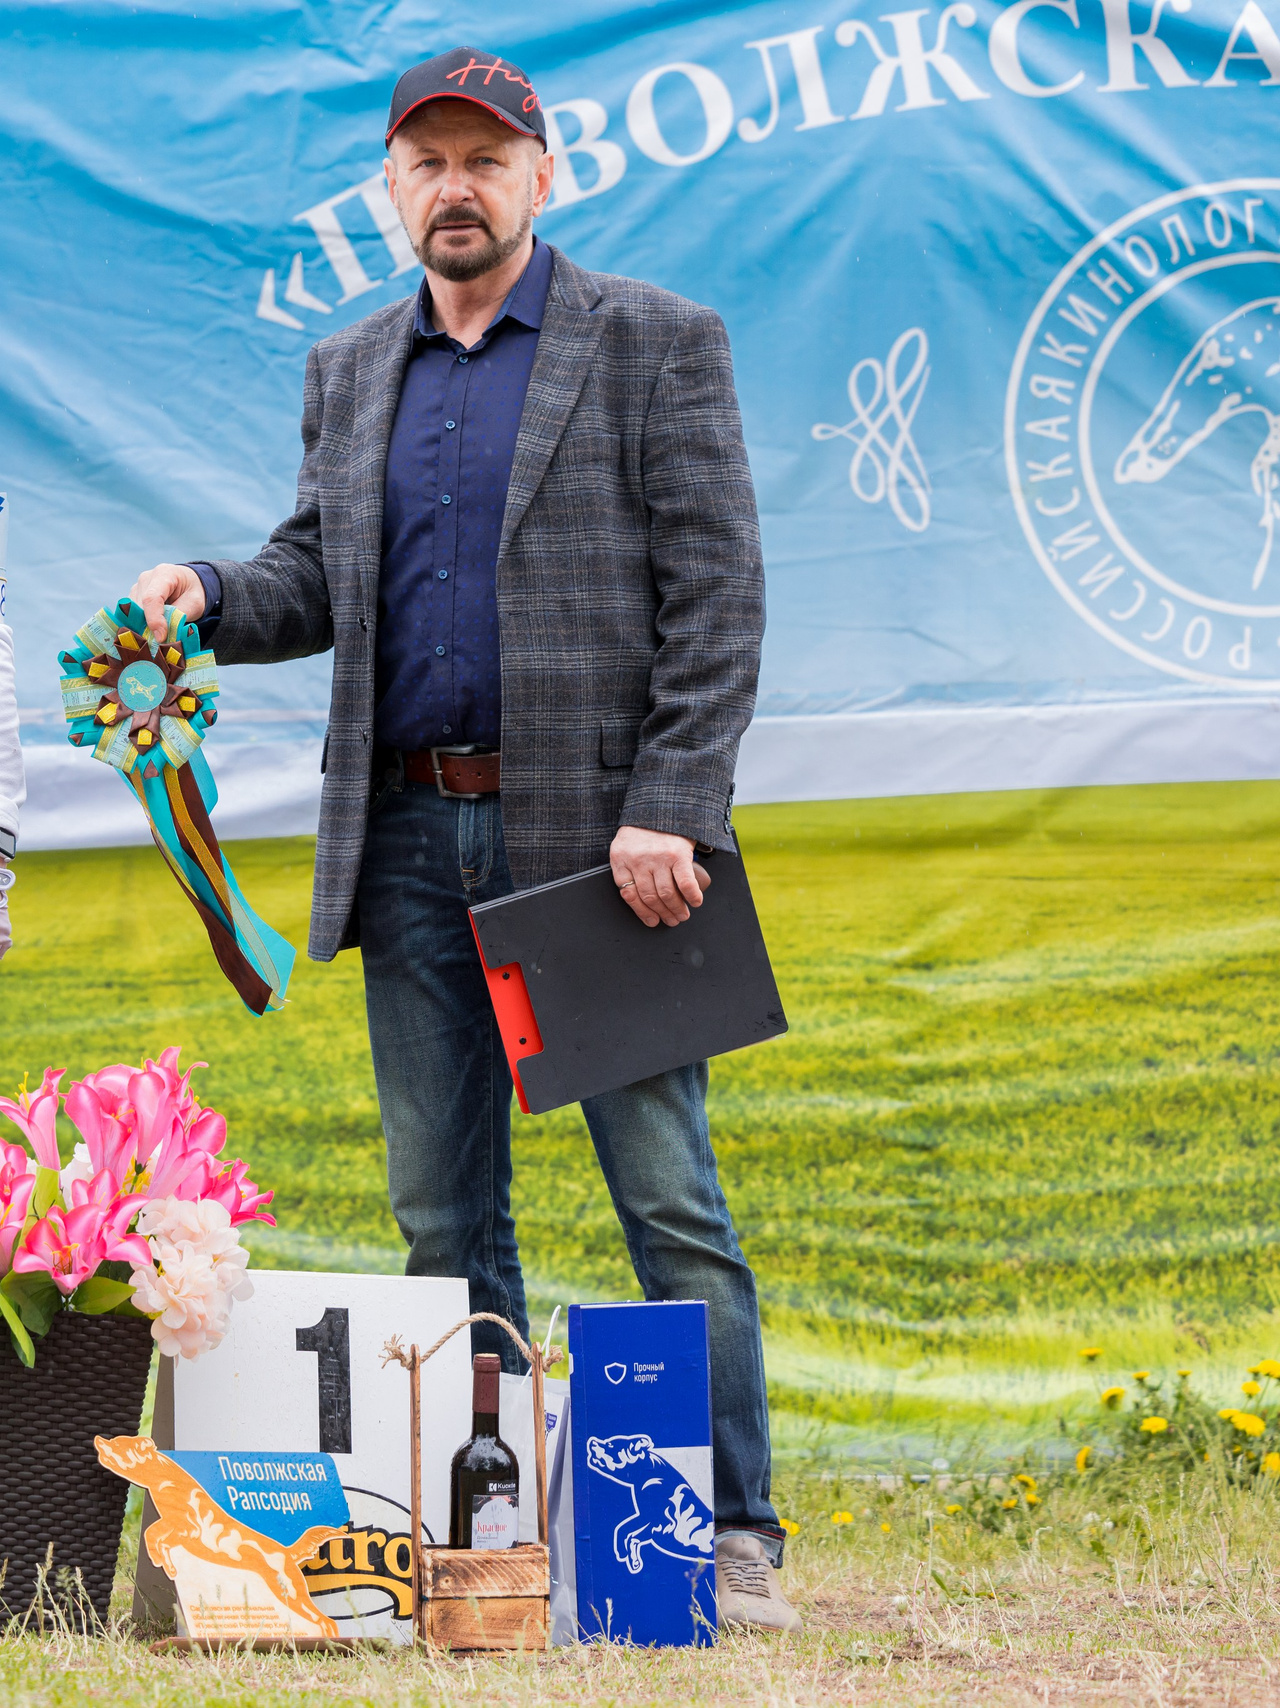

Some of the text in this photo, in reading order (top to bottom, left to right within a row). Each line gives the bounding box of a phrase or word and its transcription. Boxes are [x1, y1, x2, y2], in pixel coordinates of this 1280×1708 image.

[445, 57, 543, 114] Hug
[256, 0, 1280, 331] «ПВОЛЖСКА
[295, 1307, 352, 1454] 1
[633, 1362, 665, 1373] Прочный
[634, 1373, 658, 1384] корпус
[218, 1456, 328, 1482] Поволжская
[226, 1485, 313, 1515] Рапсодия
